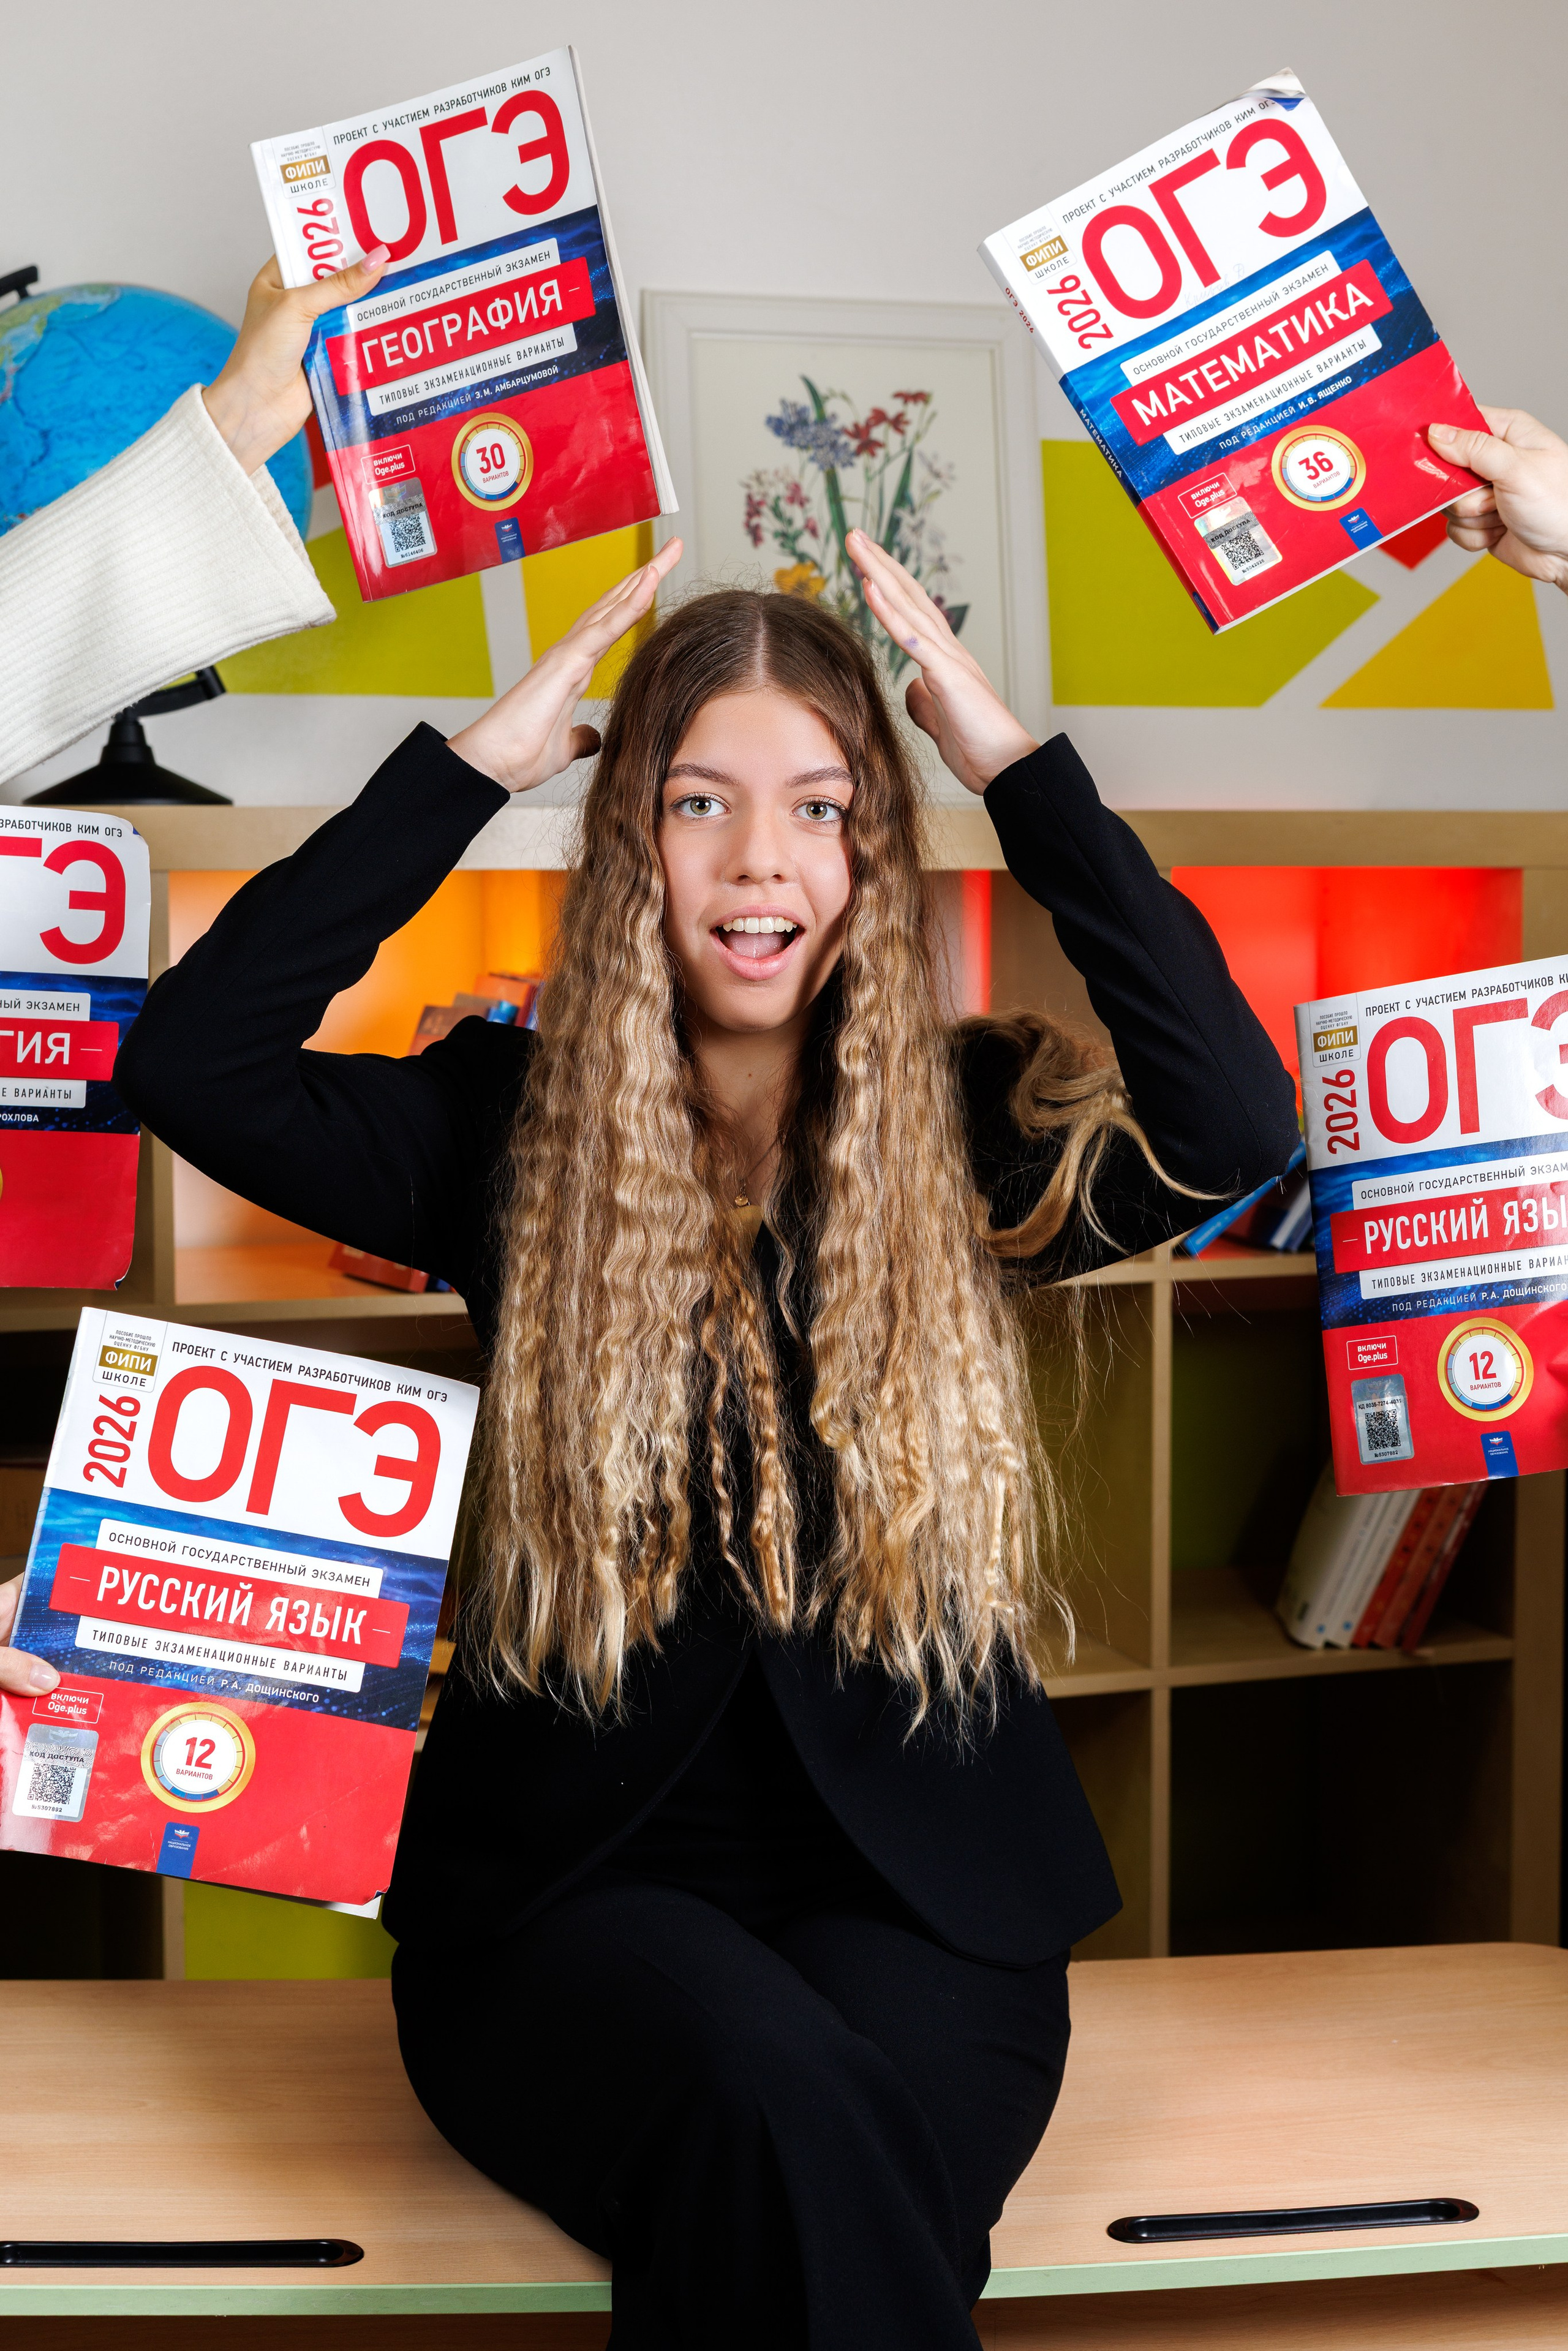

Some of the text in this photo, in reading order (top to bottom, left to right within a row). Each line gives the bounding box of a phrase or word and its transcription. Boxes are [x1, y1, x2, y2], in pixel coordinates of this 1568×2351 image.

[333, 67, 550, 145] ПРОЕКТ С УЧАСТИЕМ РАЗРАБОТЧИКОВ КИМ ОГЭ
[285, 159, 326, 179] ФИПИ
[344, 89, 570, 263] ОГЭ
[1063, 199, 1096, 223] ПРОЕКТ
[1109, 165, 1156, 197] УЧАСТИЕМ
[1158, 121, 1232, 168] РАЗРАБОТЧИКОВ
[1234, 107, 1256, 123] КИМ
[290, 178, 328, 193] ШКОЛЕ
[1082, 119, 1327, 319] ОГЭ
[1026, 240, 1063, 266] ФИПИ
[1035, 257, 1069, 278] ШКОЛЕ
[357, 251, 550, 321] ОСНОВНОЙ ГОСУДАРСТВЕННЫЙ ЭКЗАМЕН
[1005, 288, 1034, 333] ОГЭ 2026
[1046, 274, 1114, 349] 2026
[1133, 264, 1329, 375] ОСНОВНОЙ ГОСУДАРСТВЕННЫЙ ЭКЗАМЕН
[362, 279, 562, 373] ГЕОГРАФИЯ
[1131, 282, 1374, 427] МАТЕМАТИКА
[379, 337, 564, 404] ТИПОВЫЕ ЭКЗАМЕНАЦИОННЫЕ ВАРИАНТЫ
[396, 412, 415, 425] ПОД
[418, 393, 471, 417] РЕДАКЦИЕЙ
[495, 366, 558, 393] АМБАРЦУМОВОЙ
[1179, 339, 1366, 442] ТИПОВЫЕ ЭКЗАМЕНАЦИОННЫЕ ВАРИАНТЫ
[1219, 436, 1239, 449] ПОД
[1241, 406, 1295, 439] РЕДАКЦИЕЙ
[1317, 376, 1352, 399] ЯЩЕНКО
[1080, 409, 1121, 478] МАТЕМАТИКА
[373, 453, 402, 466] включи
[375, 461, 405, 476] Oge.plus
[476, 443, 505, 474] 30
[1298, 451, 1333, 480] 36
[483, 471, 509, 483] ВАРИАНТОВ
[1191, 482, 1220, 500] включи
[1313, 470, 1340, 488] ВАРИАНТОВ
[396, 502, 423, 515] ДОСТУПА
[1195, 489, 1225, 507] Oge.plus
[1210, 519, 1251, 543] КОД ДОСТУПА
[78, 824, 99, 835] КИМ
[105, 827, 123, 837] ОГЭ
[27, 1002, 80, 1011] ЭКЗАМЕН
[1366, 1002, 1400, 1016] ПРОЕКТ
[1405, 1000, 1411, 1009] С
[1415, 991, 1466, 1008] УЧАСТИЕМ
[1472, 976, 1553, 998] РАЗРАБОТЧИКОВ
[1317, 1030, 1354, 1047] ФИПИ
[1319, 1049, 1354, 1062] ШКОЛЕ
[14, 1088, 71, 1099] ВАРИАНТЫ
[1322, 1069, 1360, 1155] 2026
[1361, 1181, 1414, 1199] ОСНОВНОЙ
[1419, 1166, 1525, 1190] ГОСУДАРСТВЕННЫЙ
[1364, 1198, 1488, 1254] РУССКИЙ
[1372, 1274, 1415, 1289] ТИПОВЫЕ
[1421, 1260, 1521, 1283] ЭКЗАМЕНАЦИОННЫЕ
[1392, 1302, 1411, 1311] ПОД
[1417, 1292, 1476, 1308] РЕДАКЦИЕЙ
[1503, 1283, 1567, 1299] ДОЩИНСКОГО
[105, 1351, 152, 1372] ФИПИ
[1357, 1343, 1386, 1352] включи
[1358, 1352, 1387, 1363] Oge.plus
[102, 1371, 146, 1387] ШКОЛЕ
[172, 1342, 447, 1402] ПРОЕКТ С УЧАСТИЕМ РАЗРАБОТЧИКОВ КИМ ОГЭ
[1469, 1351, 1497, 1380] 12
[1470, 1382, 1501, 1391] ВАРИАНТОВ
[83, 1394, 141, 1488] 2026
[148, 1365, 441, 1538] ОГЭ
[109, 1533, 370, 1587] ОСНОВНОЙ ГОСУДАРСТВЕННЫЙ ЭКЗАМЕН
[97, 1565, 368, 1645] РУССКИЙ ЯЗЫК
[93, 1630, 347, 1681] ТИПОВЫЕ ЭКЗАМЕНАЦИОННЫЕ ВАРИАНТЫ
[110, 1661, 134, 1674] ПОД
[140, 1666, 214, 1685] РЕДАКЦИЕЙ
[245, 1683, 319, 1702] ДОЩИНСКОГО
[48, 1702, 87, 1715] Oge.plus
[51, 1693, 89, 1704] включи
[47, 1753, 85, 1762] ДОСТУПА
[186, 1737, 216, 1770] 12
[176, 1768, 213, 1779] ВАРИАНТОВ
